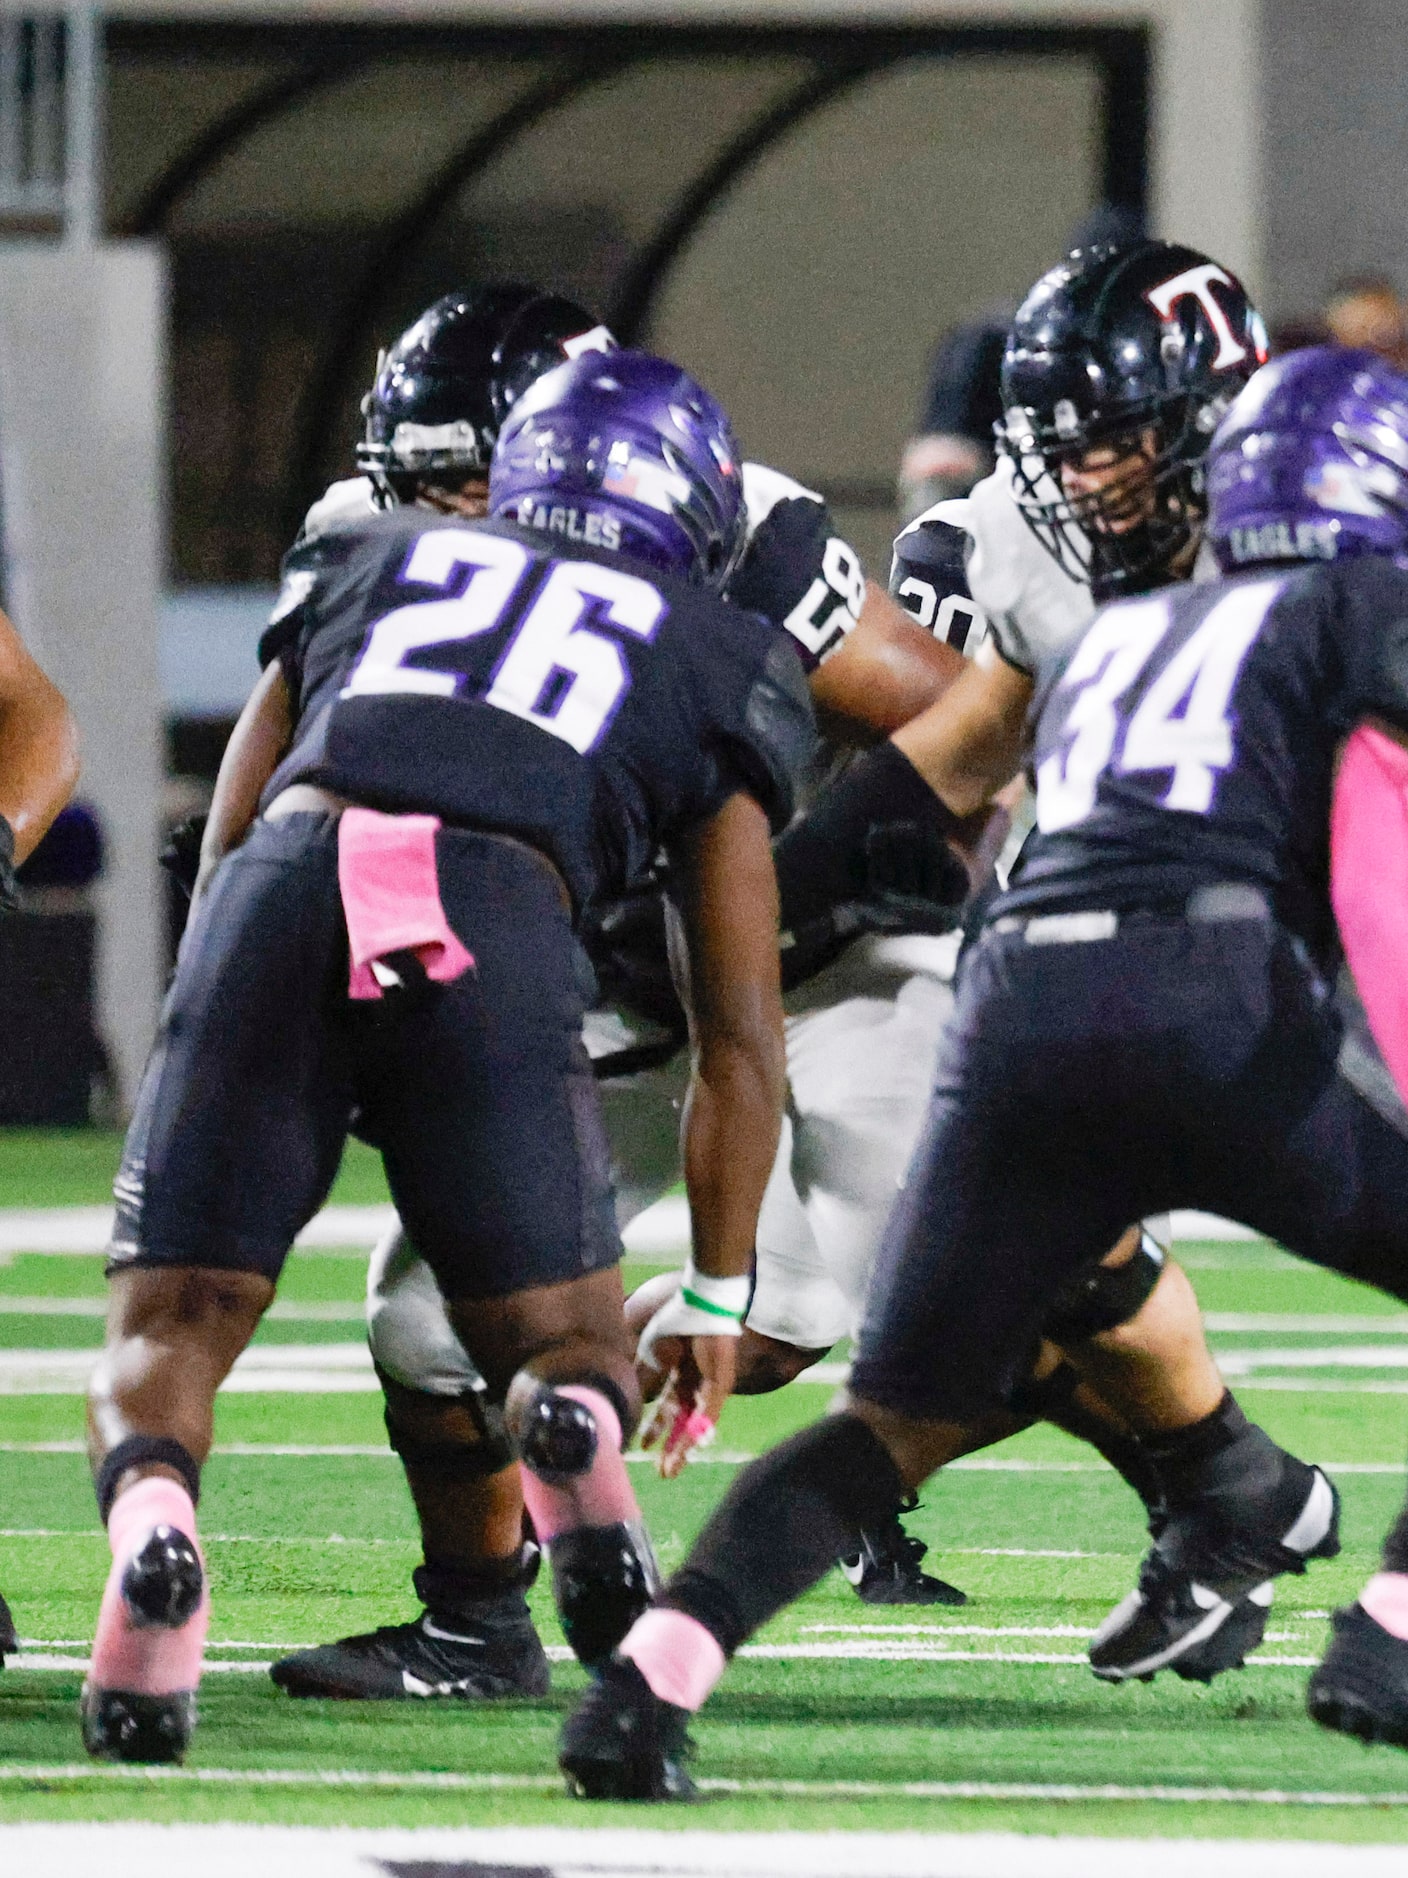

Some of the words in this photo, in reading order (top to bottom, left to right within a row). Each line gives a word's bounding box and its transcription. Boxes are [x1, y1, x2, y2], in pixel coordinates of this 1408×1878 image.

[1142, 263, 1247, 372] T
[338, 527, 669, 756] 26
[1036, 577, 1287, 834] 34
